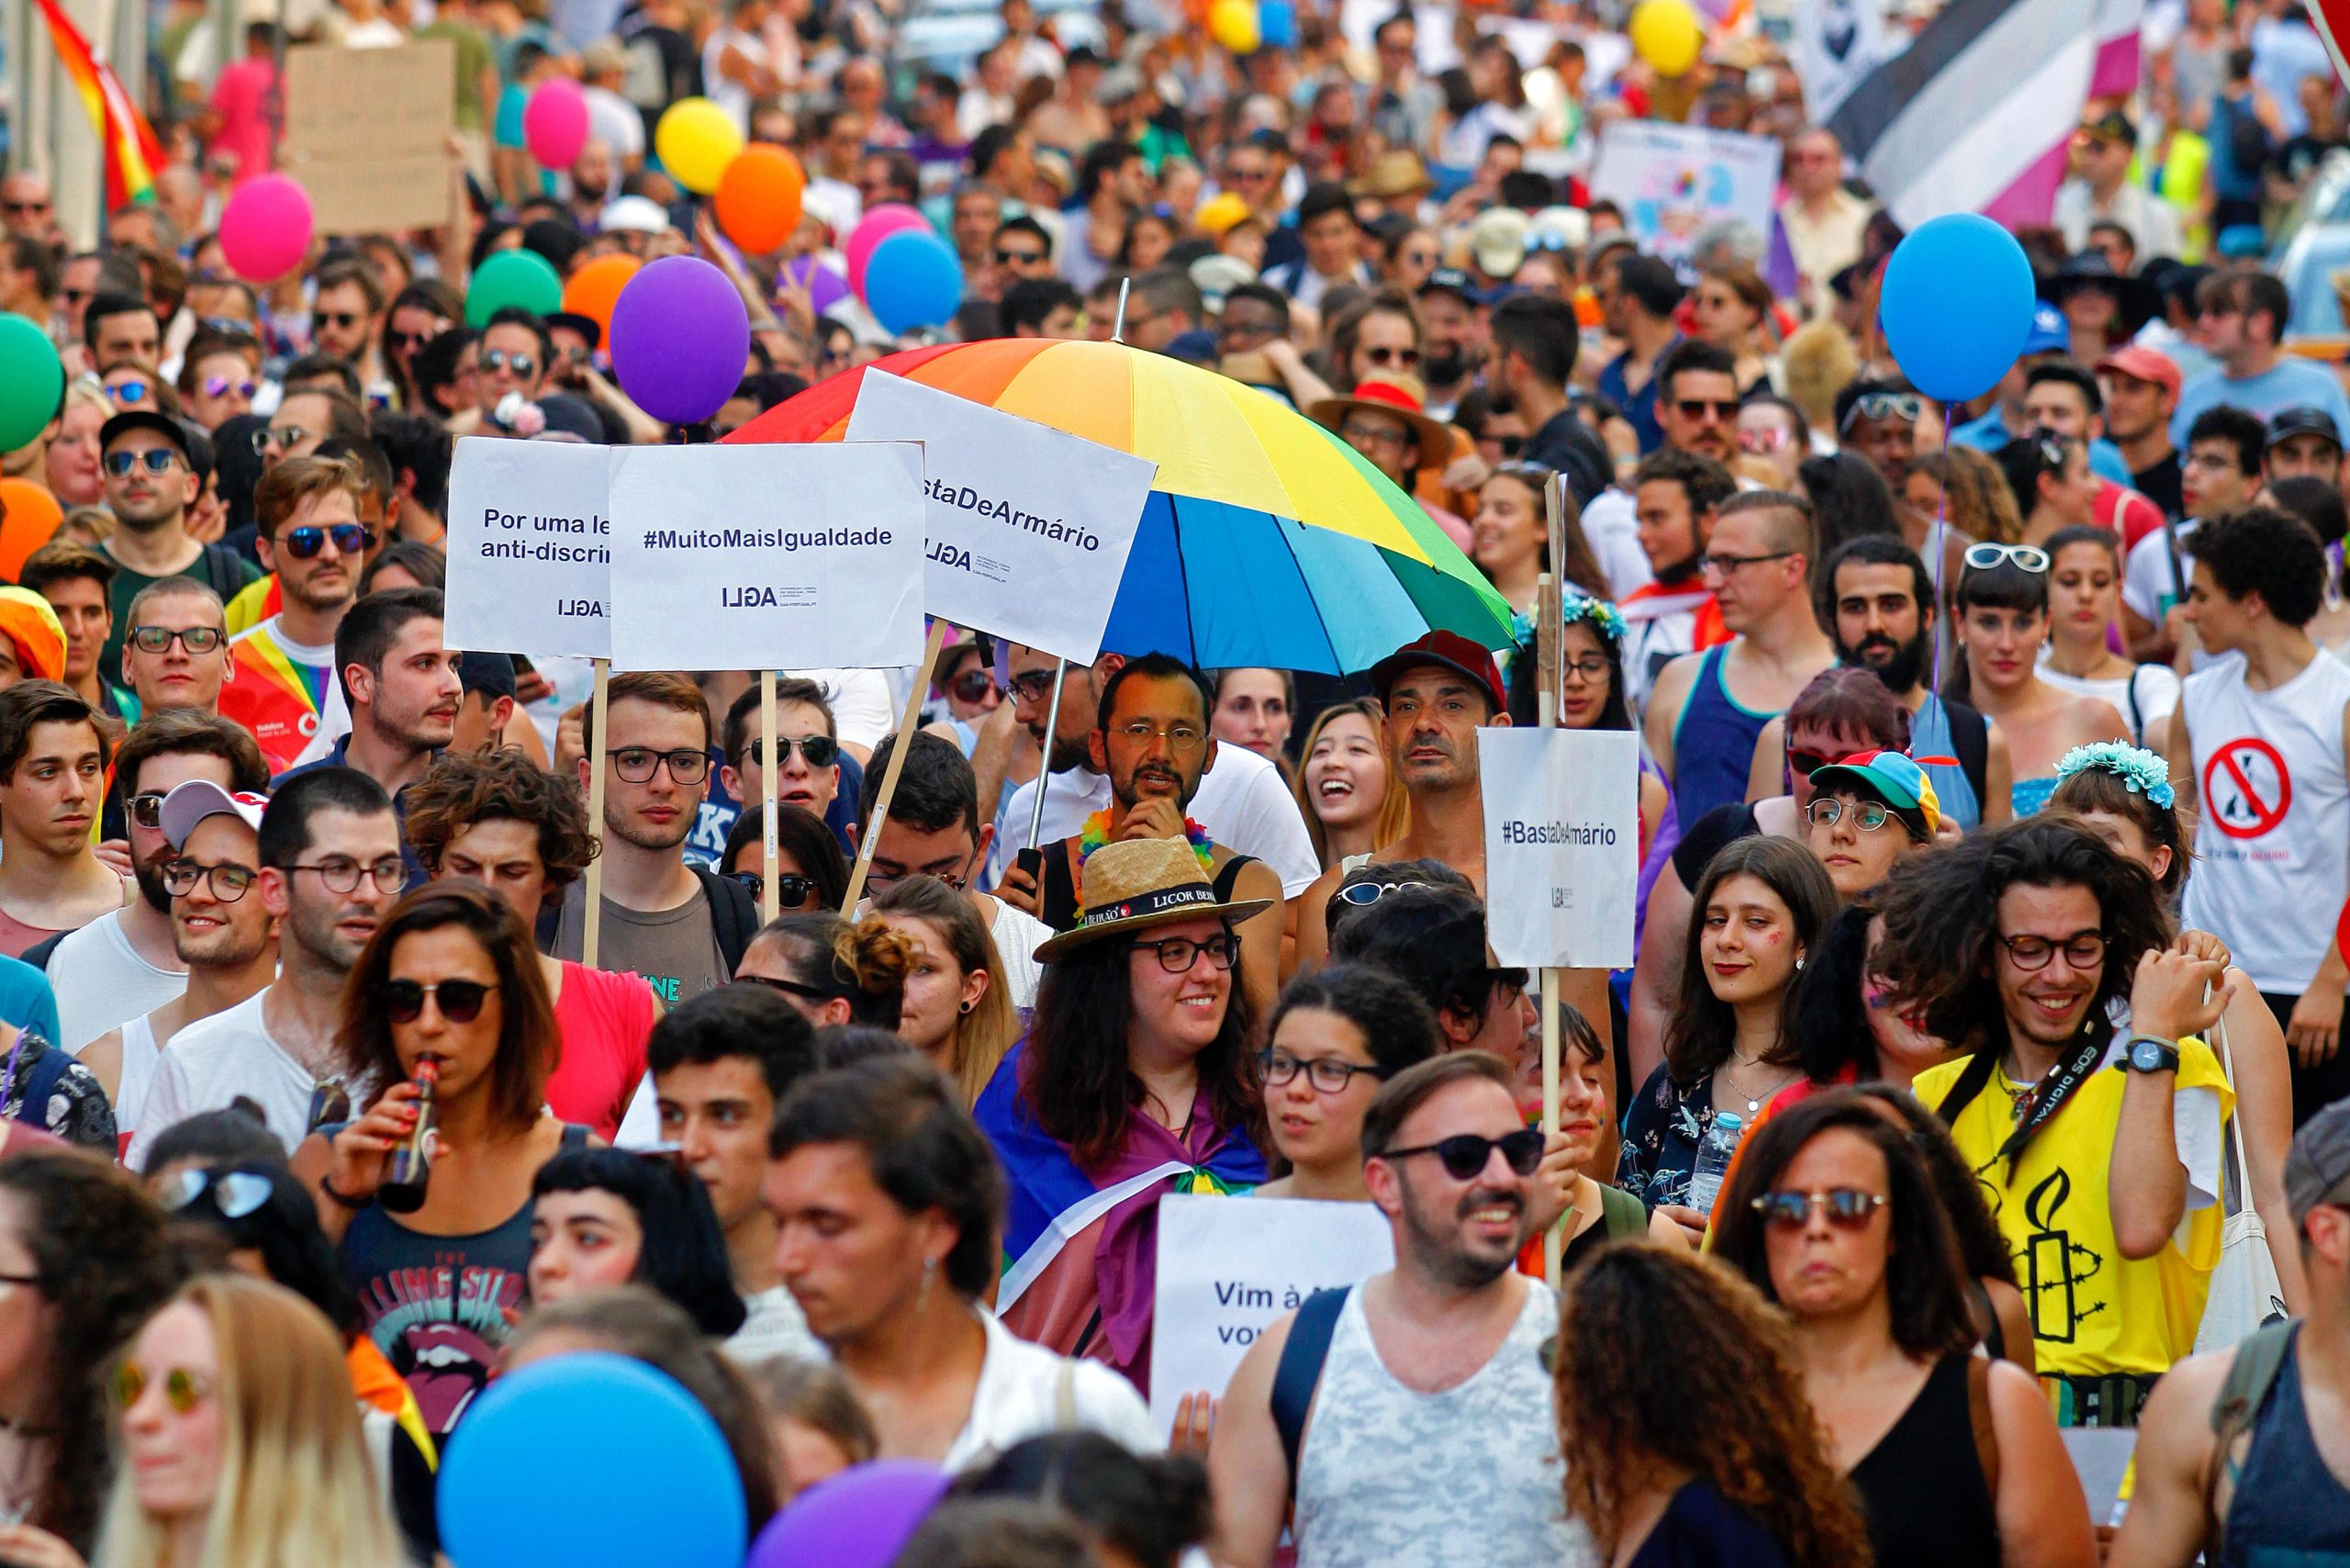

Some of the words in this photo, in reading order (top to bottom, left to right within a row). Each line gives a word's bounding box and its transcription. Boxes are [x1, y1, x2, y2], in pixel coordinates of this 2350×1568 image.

[484, 509, 527, 530] Por
[534, 516, 585, 533] uma
[643, 527, 892, 552] #MuitoMaisIgualdade
[1153, 890, 1194, 908] LICOR
[643, 975, 681, 1002] NE
[2071, 1046, 2098, 1075] EOS
[2031, 1075, 2075, 1125] DIGITAL
[1214, 1281, 1273, 1308] Vim
[1283, 1286, 1301, 1310] à
